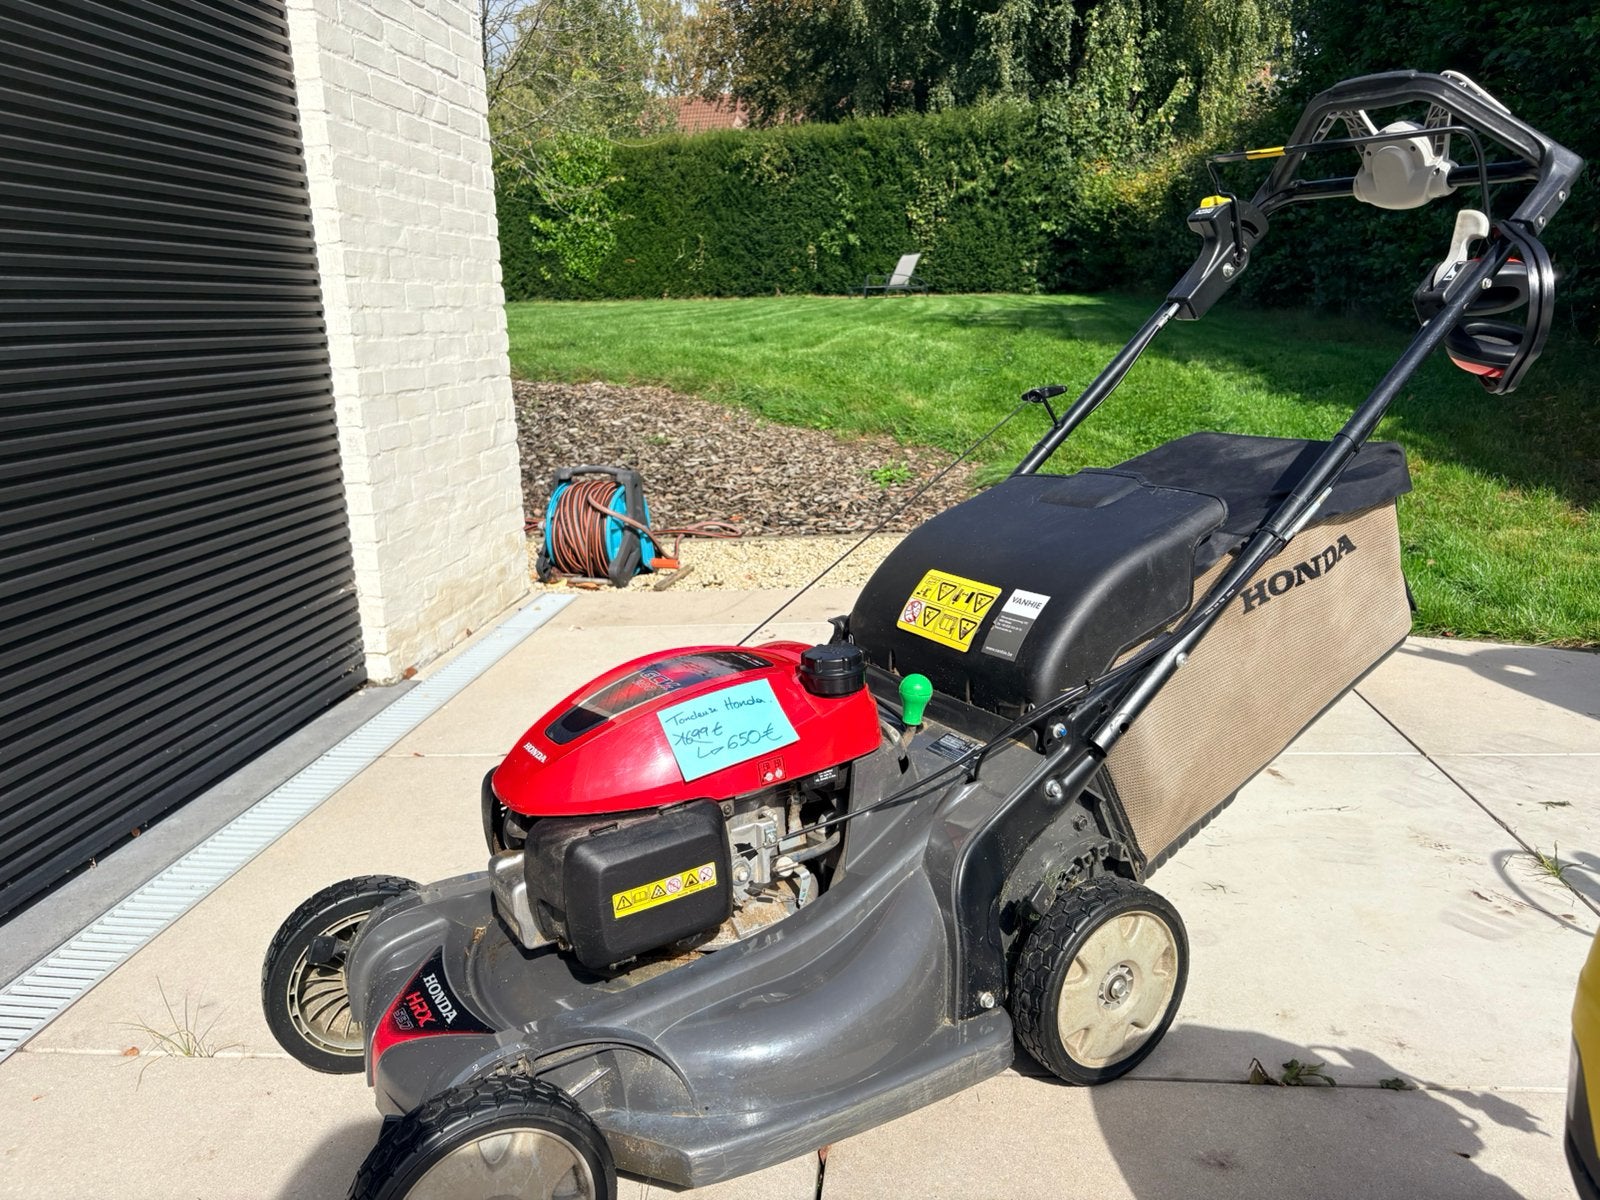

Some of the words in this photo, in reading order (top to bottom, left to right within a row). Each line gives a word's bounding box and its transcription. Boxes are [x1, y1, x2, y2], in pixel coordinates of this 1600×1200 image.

[1240, 534, 1357, 615] HONDA
[1012, 596, 1043, 610] VANHIE
[523, 741, 548, 764] HONDA
[405, 991, 436, 1028] HRX
[422, 972, 458, 1025] HONDA
